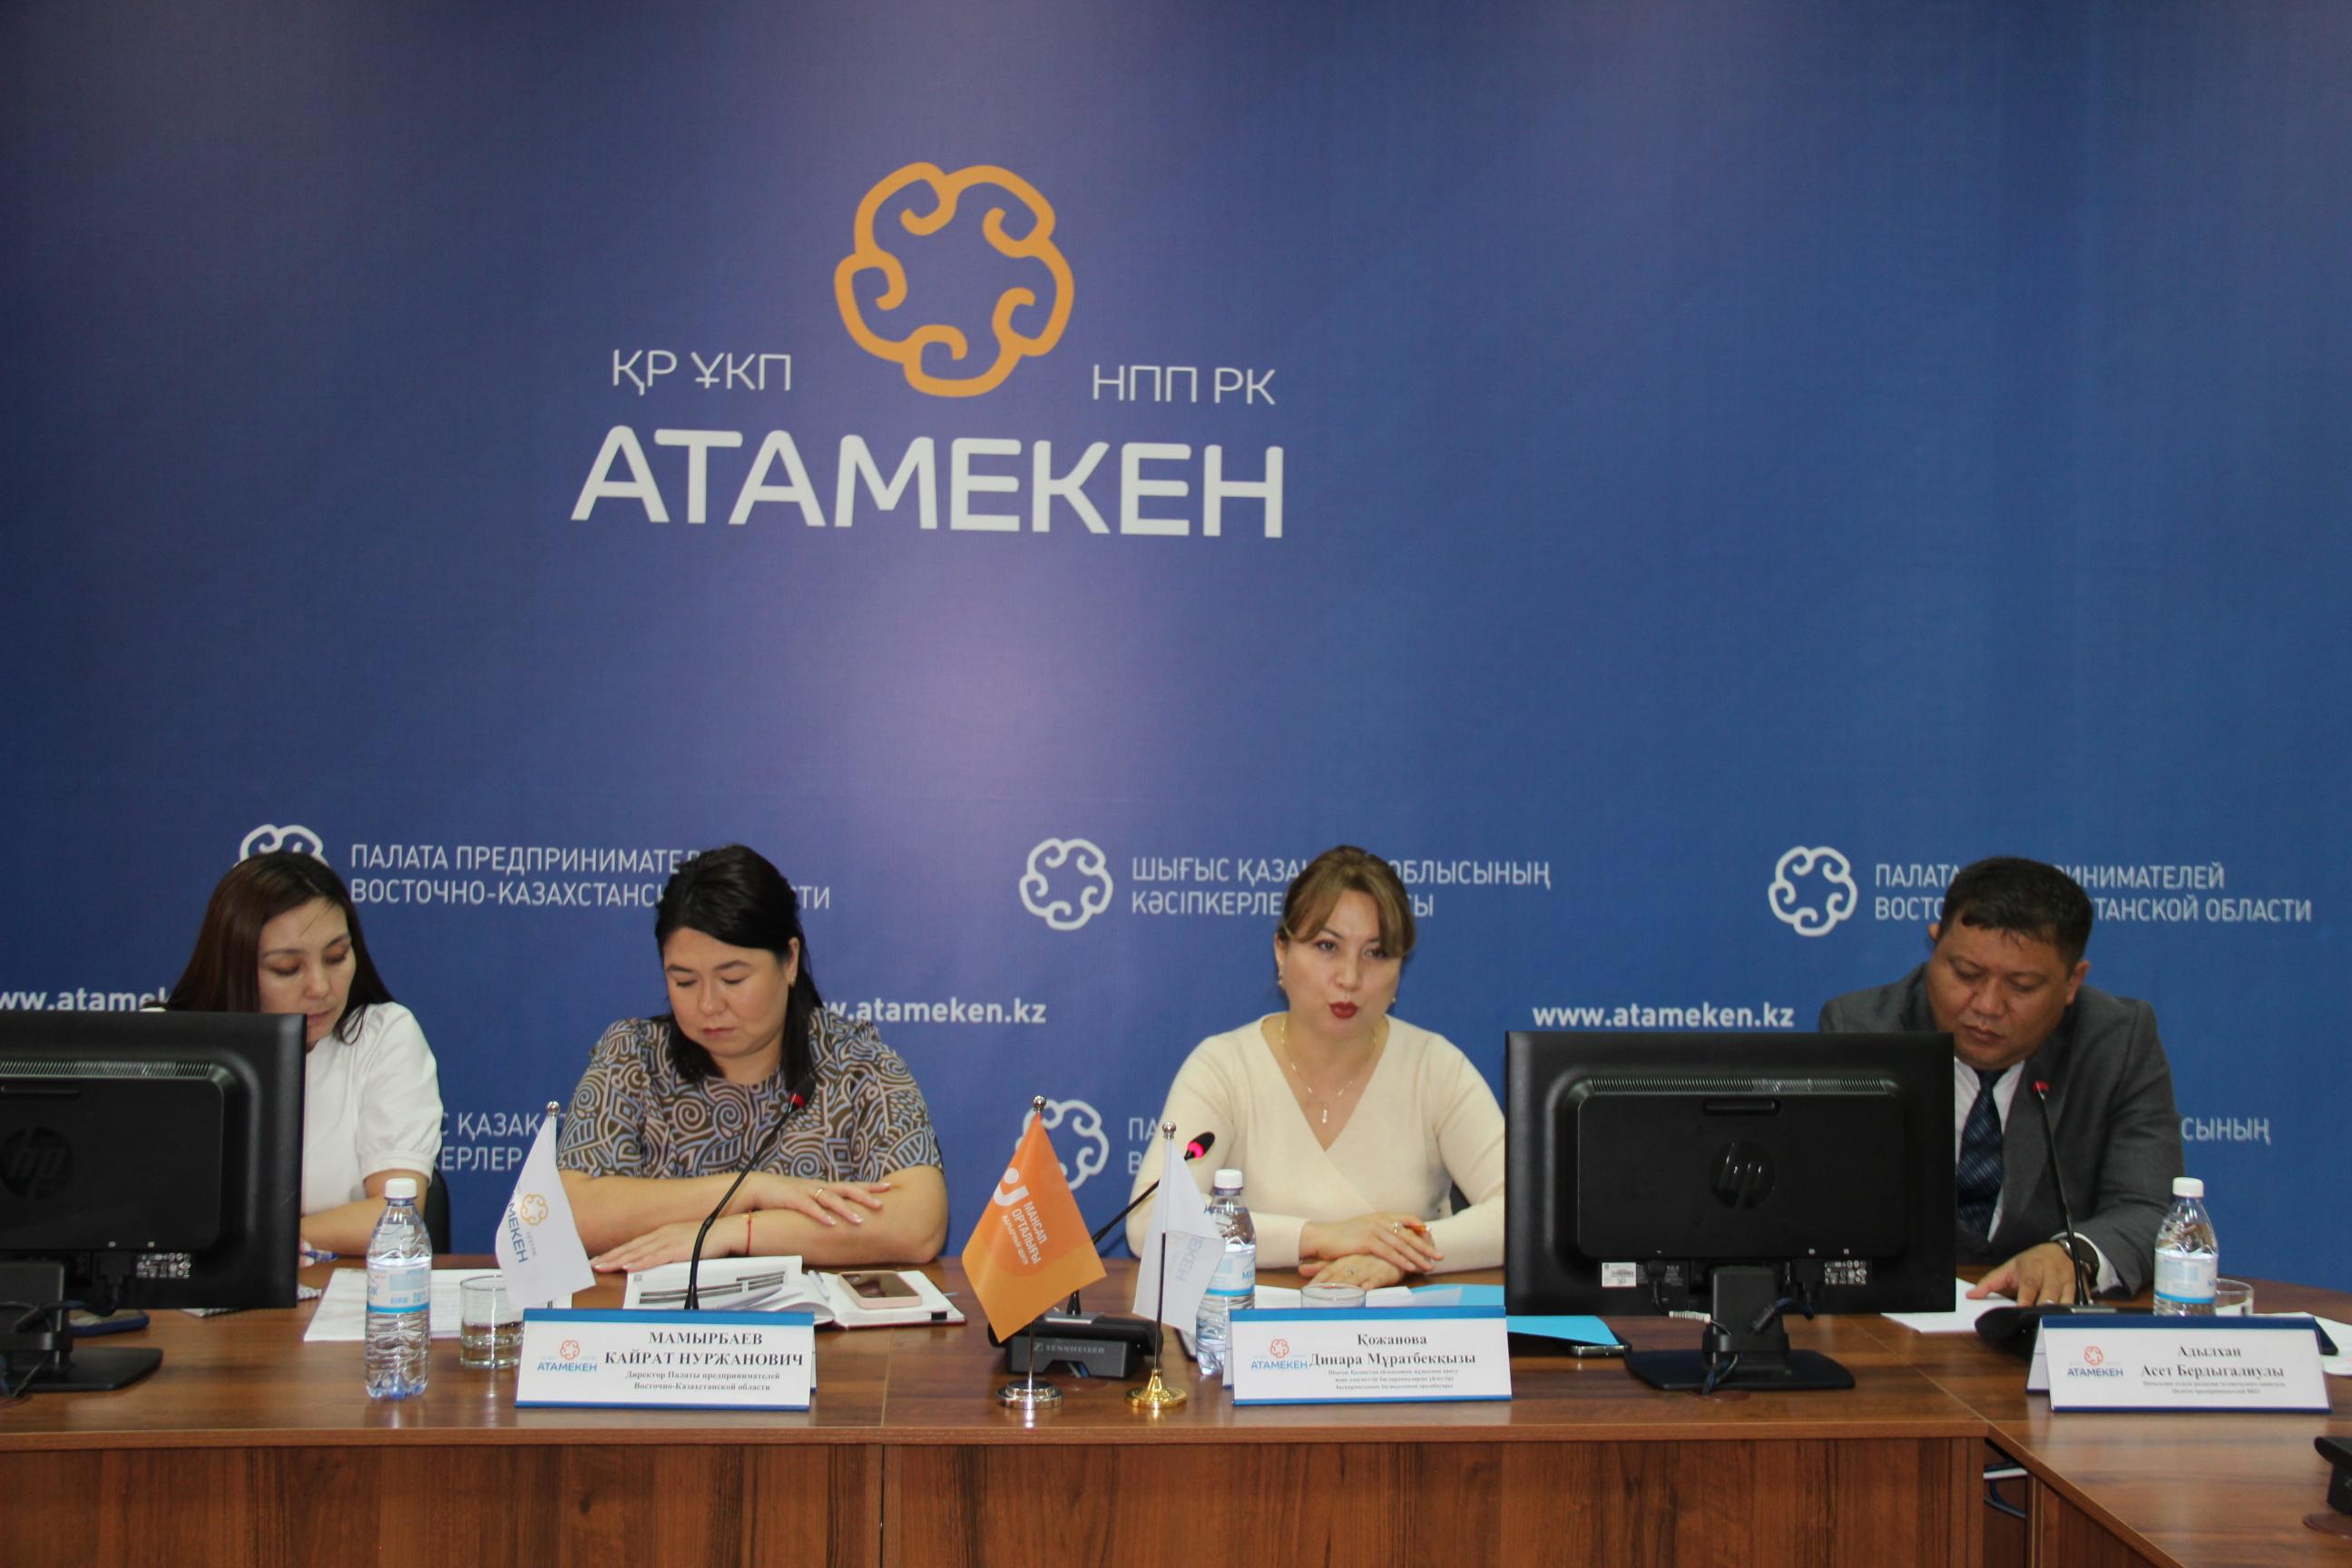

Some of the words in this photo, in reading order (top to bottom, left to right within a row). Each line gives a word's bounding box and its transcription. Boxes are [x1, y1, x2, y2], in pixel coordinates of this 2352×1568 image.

[613, 348, 678, 397] ҚР
[691, 351, 791, 391] ҰКП
[1093, 364, 1198, 404] НПП
[1214, 367, 1276, 406] РК
[571, 426, 1284, 538] АТАМЕКЕН
[350, 843, 448, 870] ПАЛАТА
[456, 845, 702, 875] ПРЕДПРИНИМАТЕ
[1132, 857, 1230, 882] ШЫҒЫС
[350, 877, 664, 907] ВОСТОЧНО-КАЗАХСТАНС
[1132, 890, 1283, 916] КӘСІПКЕРЛЕ
[2205, 897, 2312, 923] ОБЛАСТИ
[822, 997, 1047, 1024] w.atameken.kz
[1532, 1002, 1795, 1028] www.atameken.kz
[2180, 1116, 2271, 1146] СЫНЫҢ
[648, 1331, 763, 1346] МАМЫРБАЕВ
[536, 1362, 598, 1372] АТАМЕКЕН
[604, 1348, 675, 1365] КАЙРАТ
[680, 1351, 804, 1366] НУРЖАНОВИЧ
[1250, 1360, 1308, 1370] АТАМЕКЕН
[1308, 1352, 1363, 1367] Динара
[625, 1369, 666, 1380] Директор
[2067, 1367, 2123, 1377] АТАМЕКЕН
